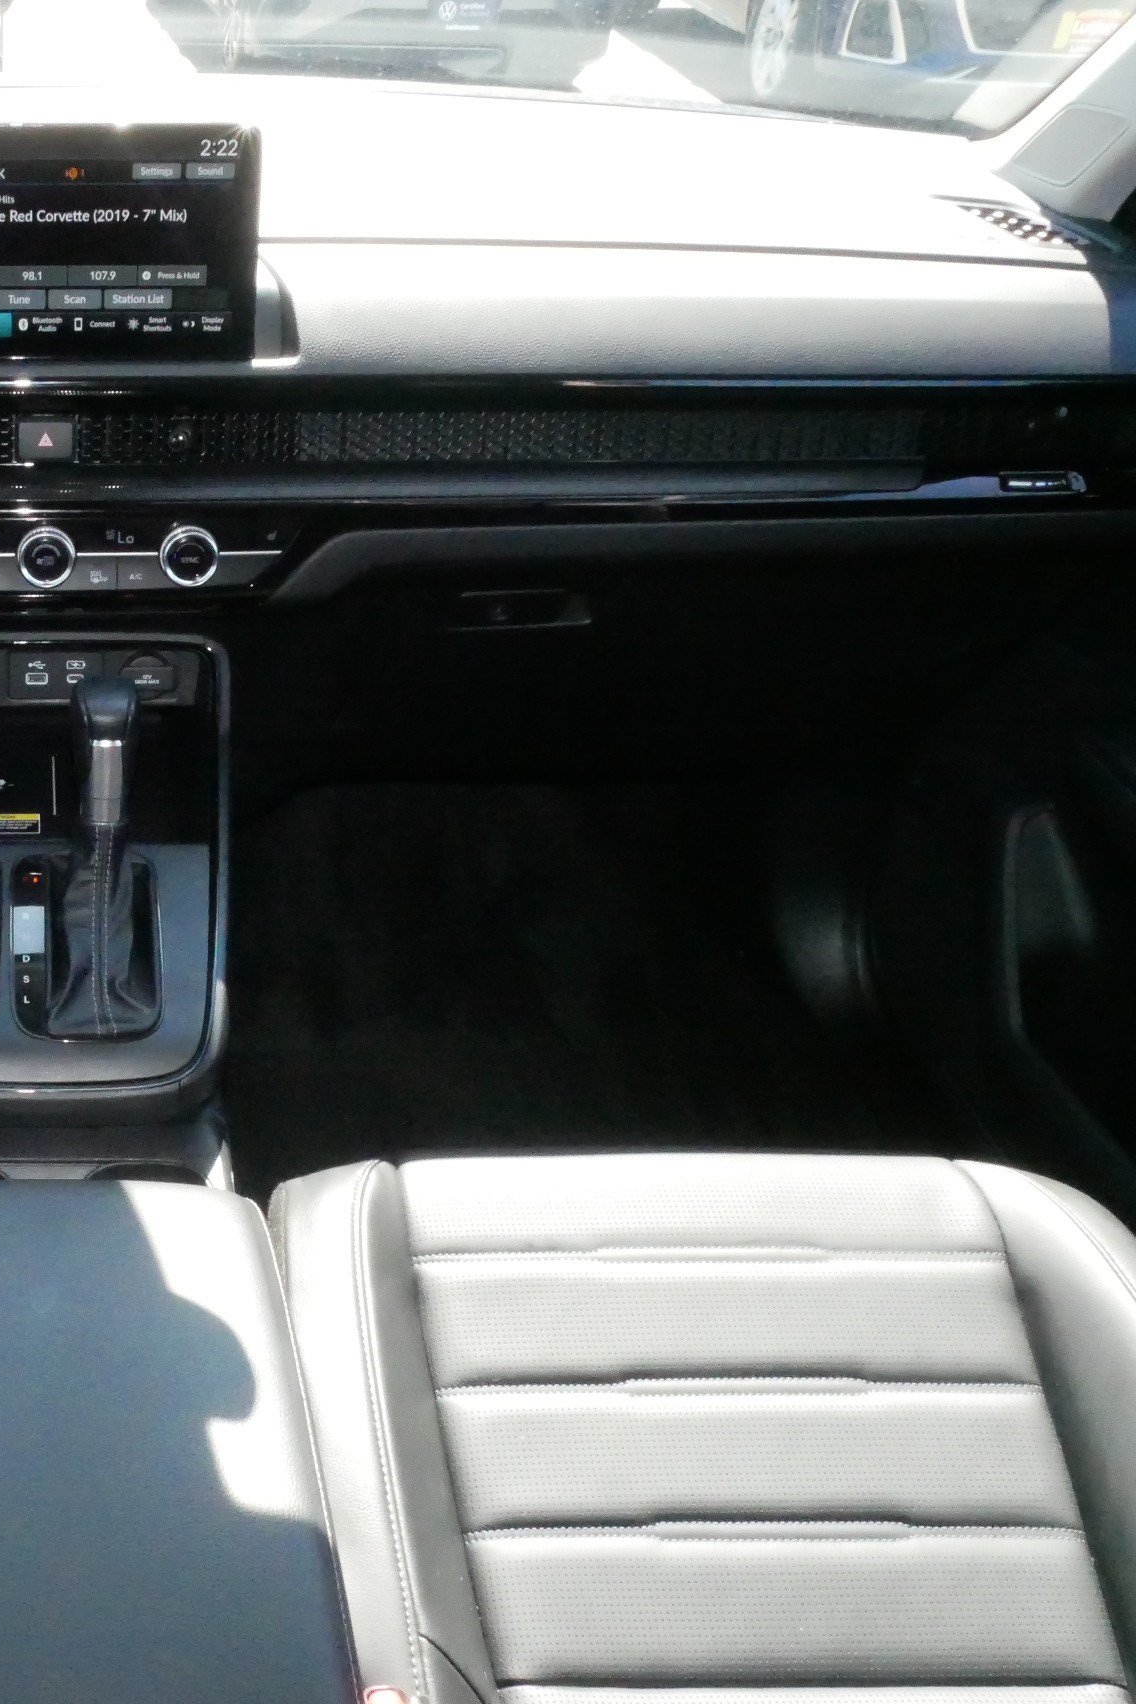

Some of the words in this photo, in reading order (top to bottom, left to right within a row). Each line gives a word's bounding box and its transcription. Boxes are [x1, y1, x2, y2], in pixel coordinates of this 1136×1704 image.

[200, 139, 239, 157] 2:22
[140, 166, 174, 177] Settings
[197, 166, 224, 176] Sound
[9, 210, 33, 223] Red
[36, 210, 90, 223] Corvette
[93, 208, 130, 224] (2019
[159, 208, 187, 224] Mix)
[22, 271, 42, 281] 98.1
[89, 270, 117, 281] 107.9
[157, 271, 175, 280] Press
[183, 271, 200, 280] Hold
[8, 294, 31, 305] Tune
[64, 294, 87, 305] Scan
[112, 293, 145, 304] Station
[147, 293, 165, 304] List
[32, 316, 63, 325] Bluetooth
[90, 320, 116, 328] Connect
[148, 316, 167, 324] Smart
[201, 316, 225, 325] Display
[143, 324, 172, 332] Shortcuts
[117, 533, 134, 544] Lo
[180, 555, 200, 564] SYNC
[22, 955, 31, 963] D
[23, 975, 30, 983] S
[23, 995, 31, 1004] L
